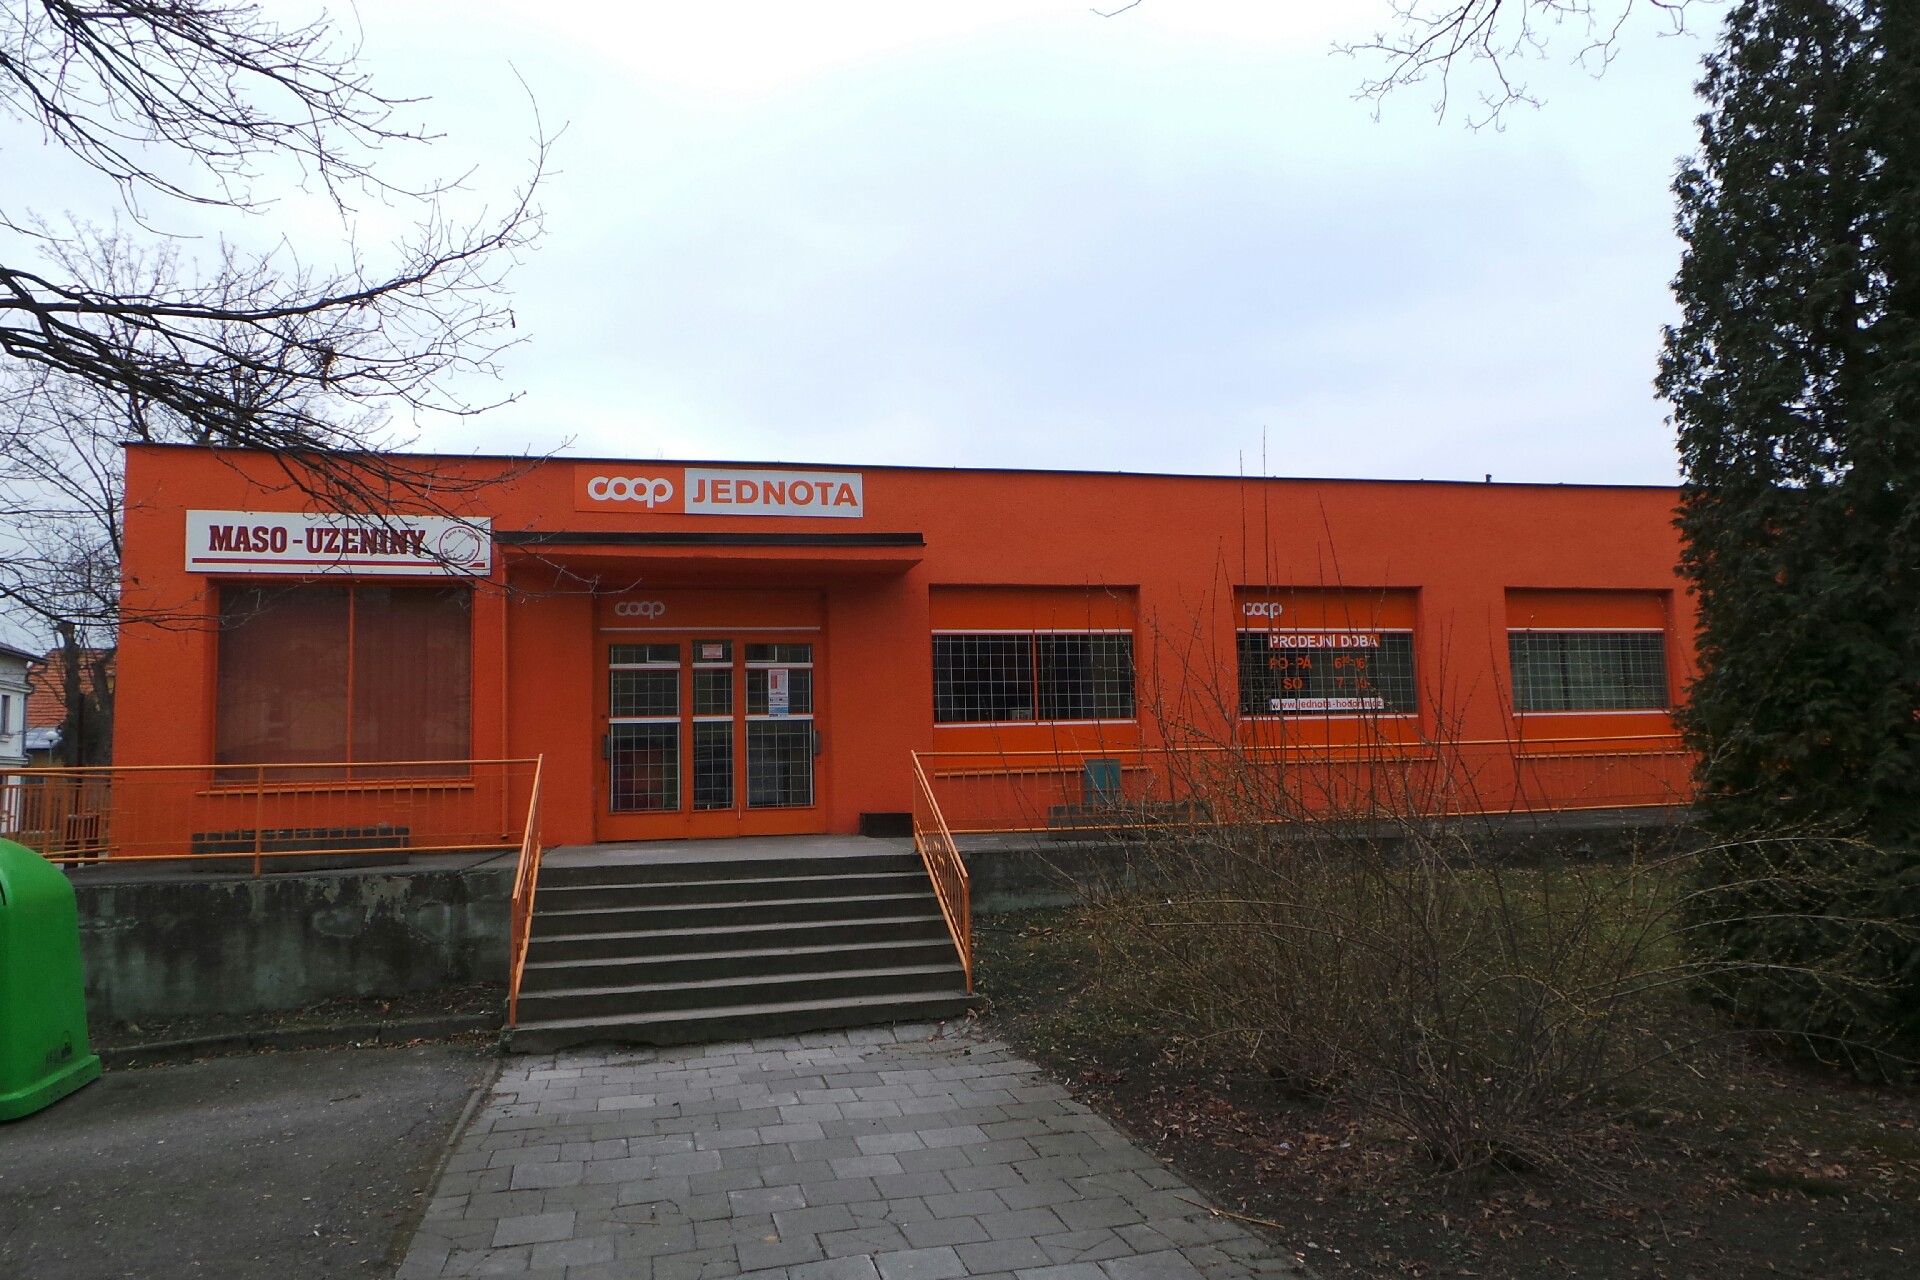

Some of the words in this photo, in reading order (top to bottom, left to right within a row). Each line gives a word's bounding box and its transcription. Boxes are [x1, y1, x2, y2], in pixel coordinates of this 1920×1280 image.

[587, 476, 674, 508] coop
[692, 478, 858, 507] JEDNOTA
[208, 525, 288, 553] MASO
[614, 600, 665, 620] coop
[1242, 602, 1283, 619] coop
[1269, 634, 1336, 648] PRODEJNÍ
[1340, 635, 1378, 648] DOBA
[1283, 677, 1304, 690] SO
[1271, 698, 1383, 710] www.jednota-hodonncz
